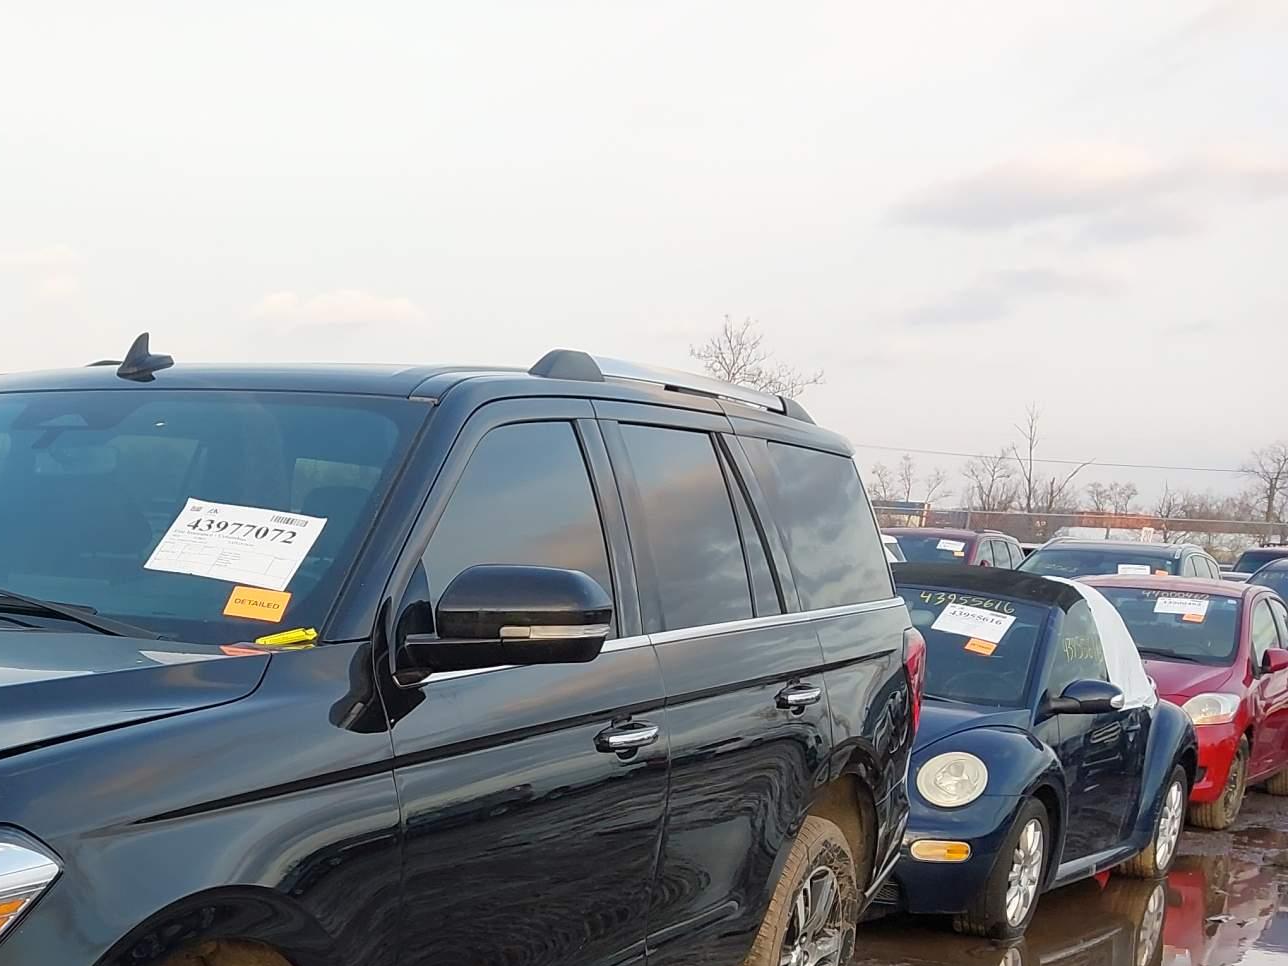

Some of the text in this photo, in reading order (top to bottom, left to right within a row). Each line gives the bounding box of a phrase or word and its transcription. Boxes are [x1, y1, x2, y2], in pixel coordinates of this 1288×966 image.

[186, 517, 297, 545] 43977072
[233, 597, 280, 611] DETAILED
[920, 591, 1016, 614] 43955616
